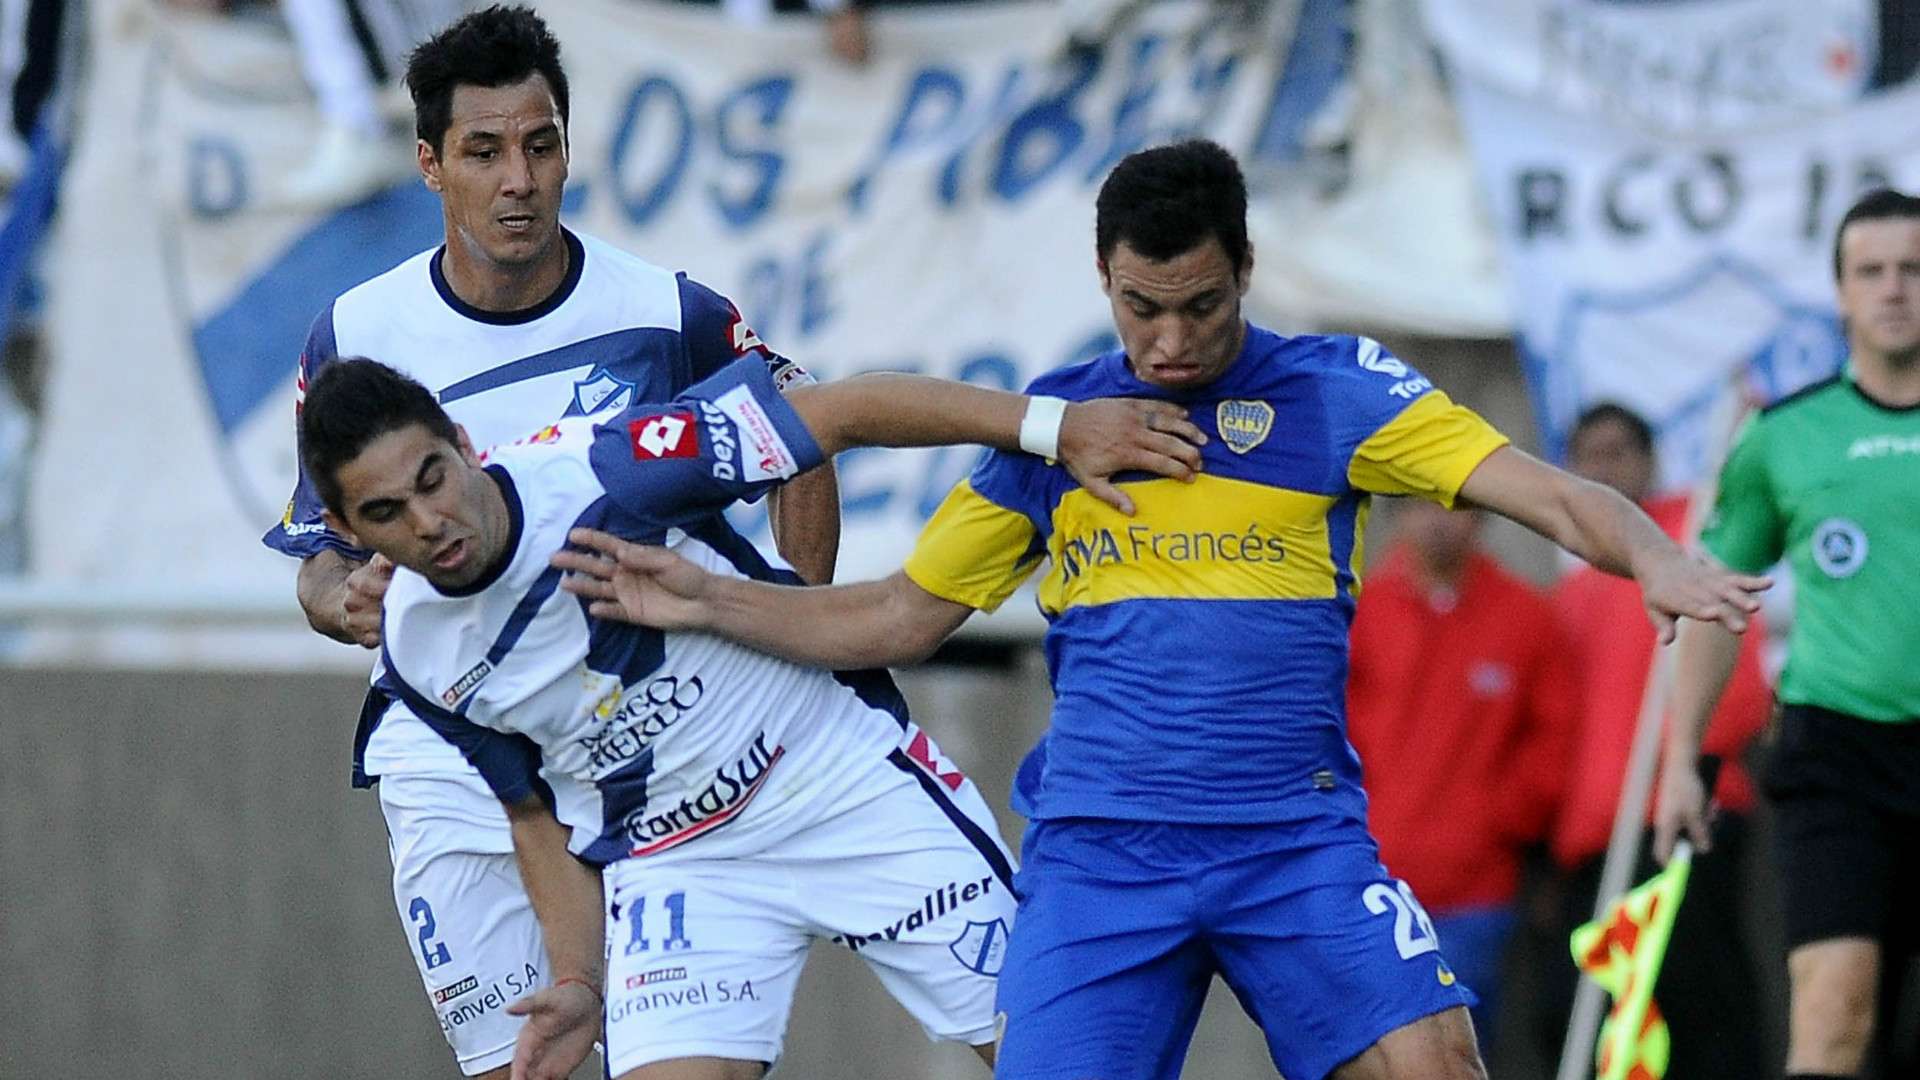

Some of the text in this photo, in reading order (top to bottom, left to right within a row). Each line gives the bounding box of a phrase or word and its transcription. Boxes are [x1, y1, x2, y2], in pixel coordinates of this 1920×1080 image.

[559, 74, 796, 227] OS
[1128, 522, 1286, 563] Francés
[409, 896, 452, 970] 2
[624, 893, 691, 956] 11
[611, 980, 760, 1022] Granvel S.A.
